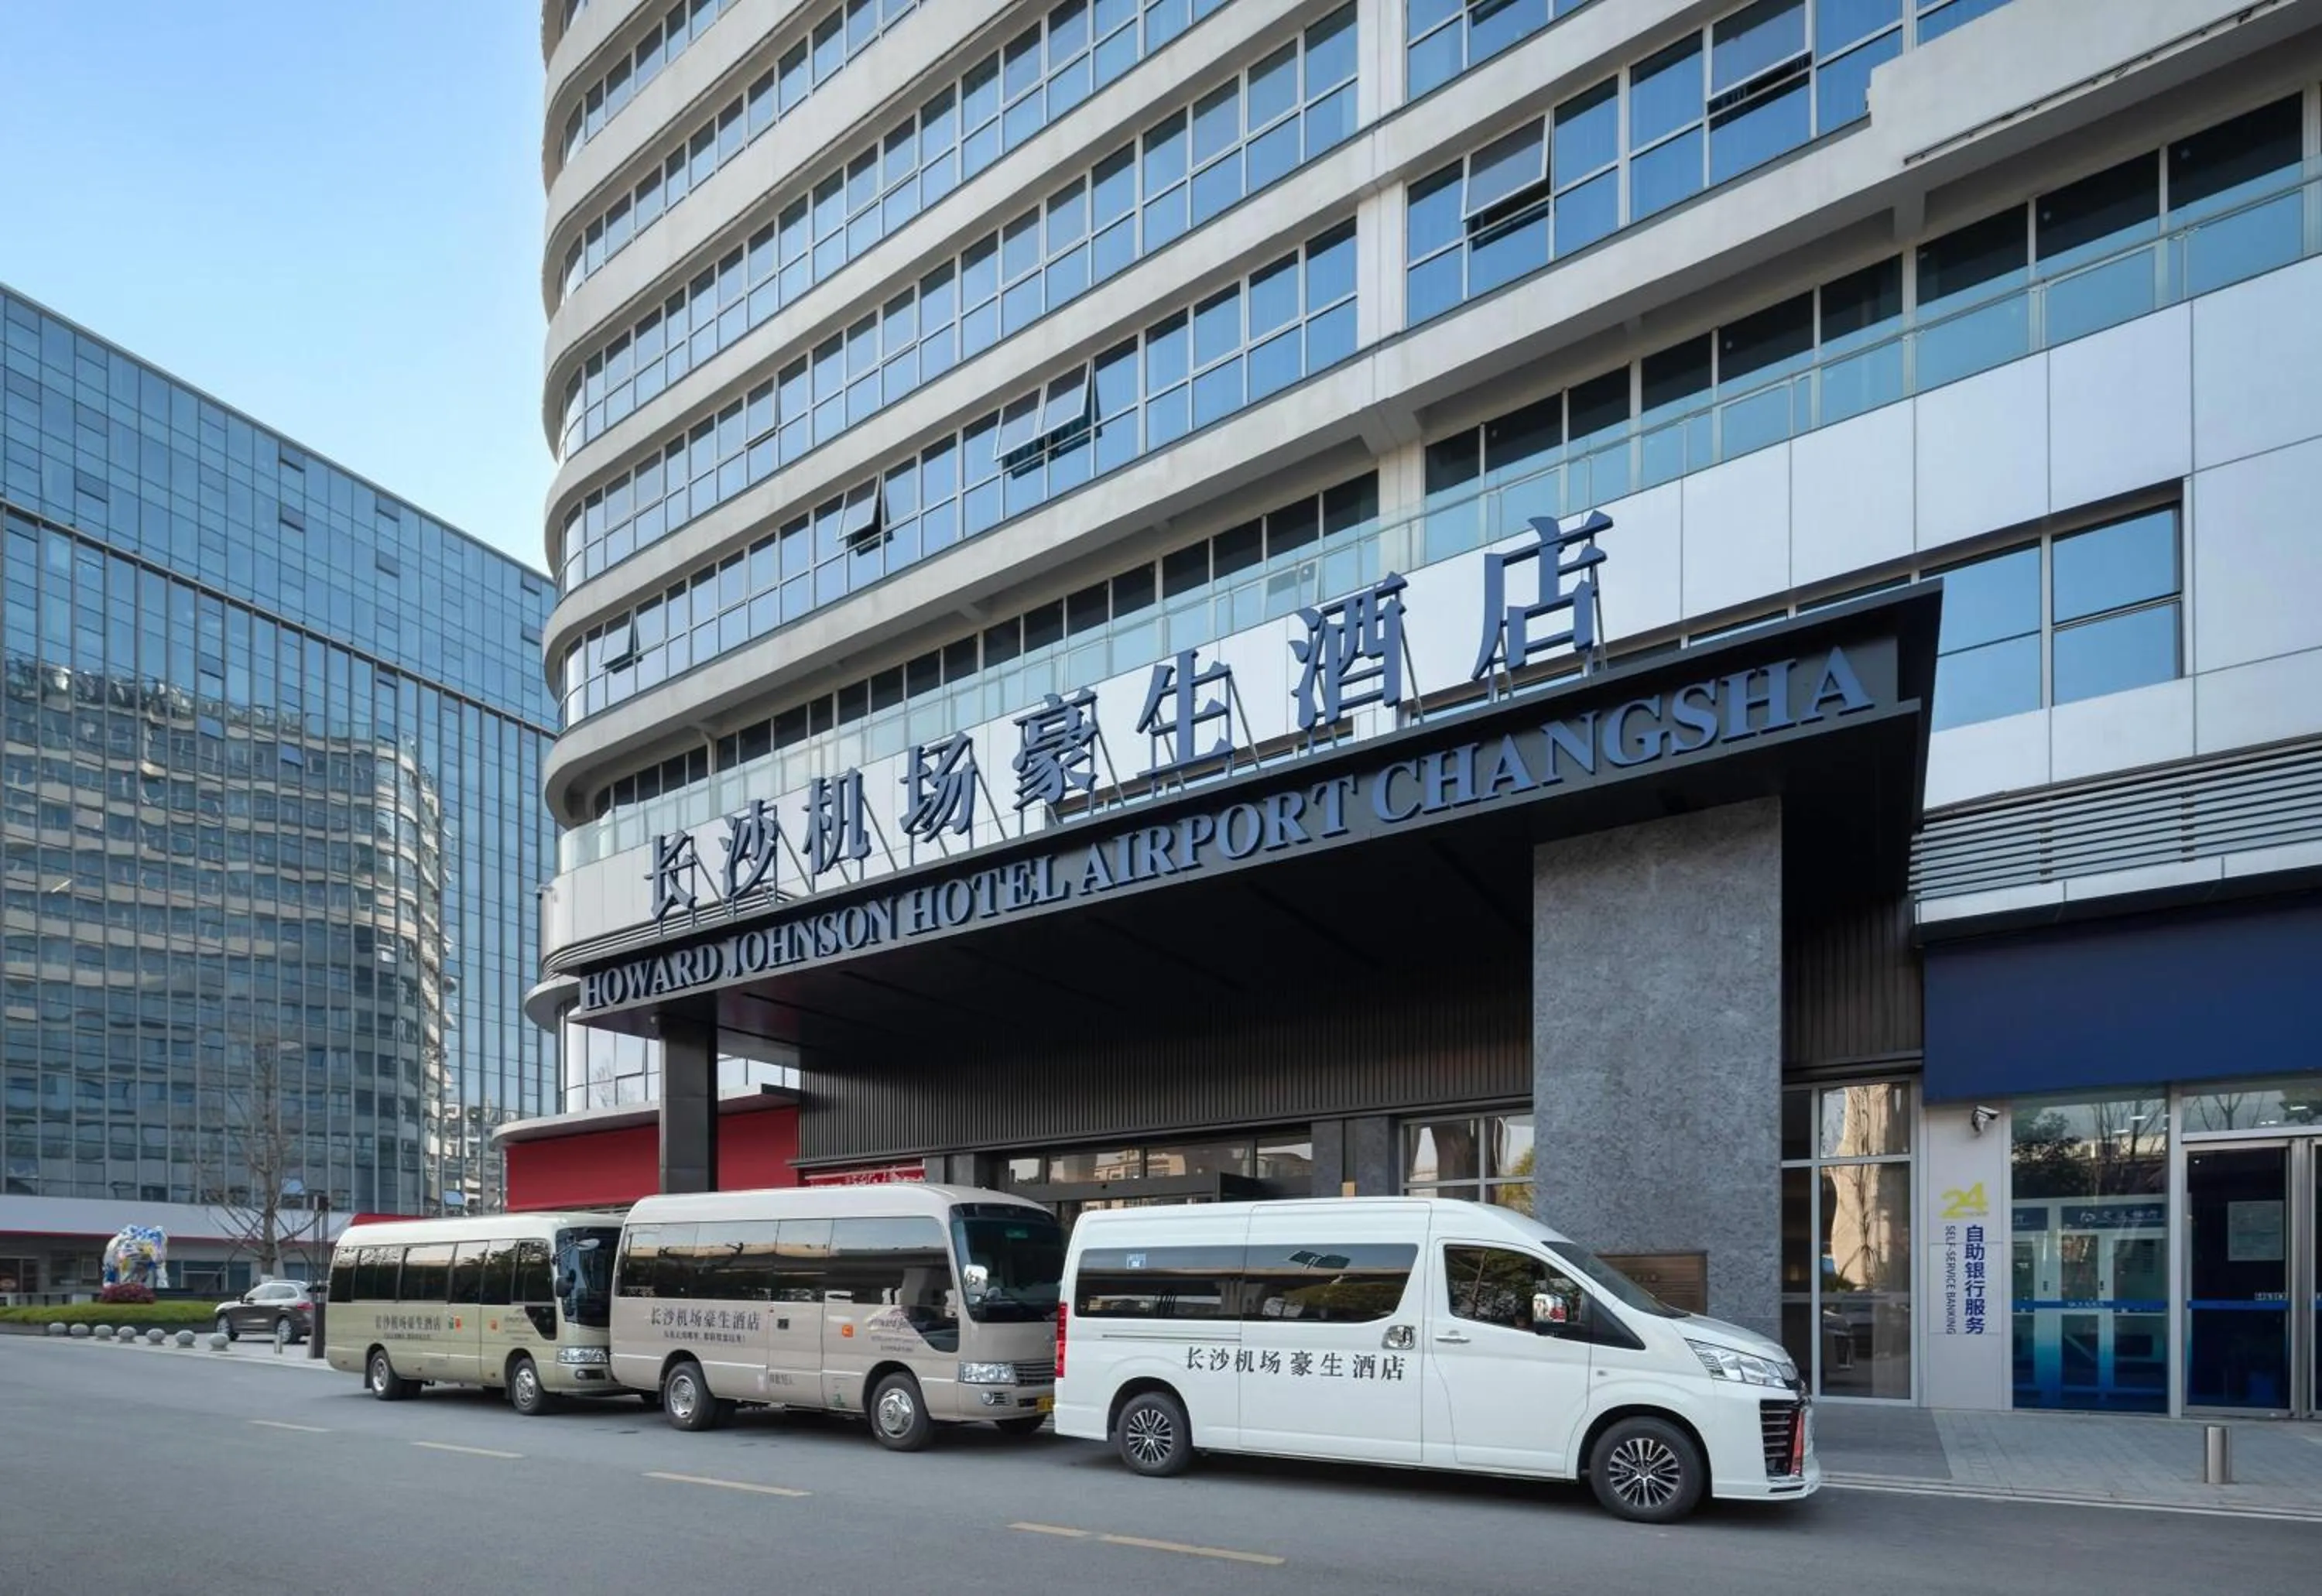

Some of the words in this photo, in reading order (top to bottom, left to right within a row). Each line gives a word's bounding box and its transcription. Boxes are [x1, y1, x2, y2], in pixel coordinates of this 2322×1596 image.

[644, 509, 1614, 920] 长沙机场豪生酒店
[580, 944, 723, 1011] HOWARD
[727, 893, 900, 977] JOHNSON
[905, 854, 1070, 936] HOTEL
[1078, 774, 1359, 895] AIRPORT
[1371, 646, 1875, 824] CHANGSHA
[1940, 1182, 1986, 1218] 24
[1945, 1225, 1957, 1289] SELF-SERVICE
[1964, 1224, 1985, 1335] 自助银行服务
[651, 1306, 760, 1332] 长沙机场豪生酒店
[1945, 1292, 1957, 1335] BANKING
[1186, 1346, 1406, 1382] 长沙机场豪生酒店
